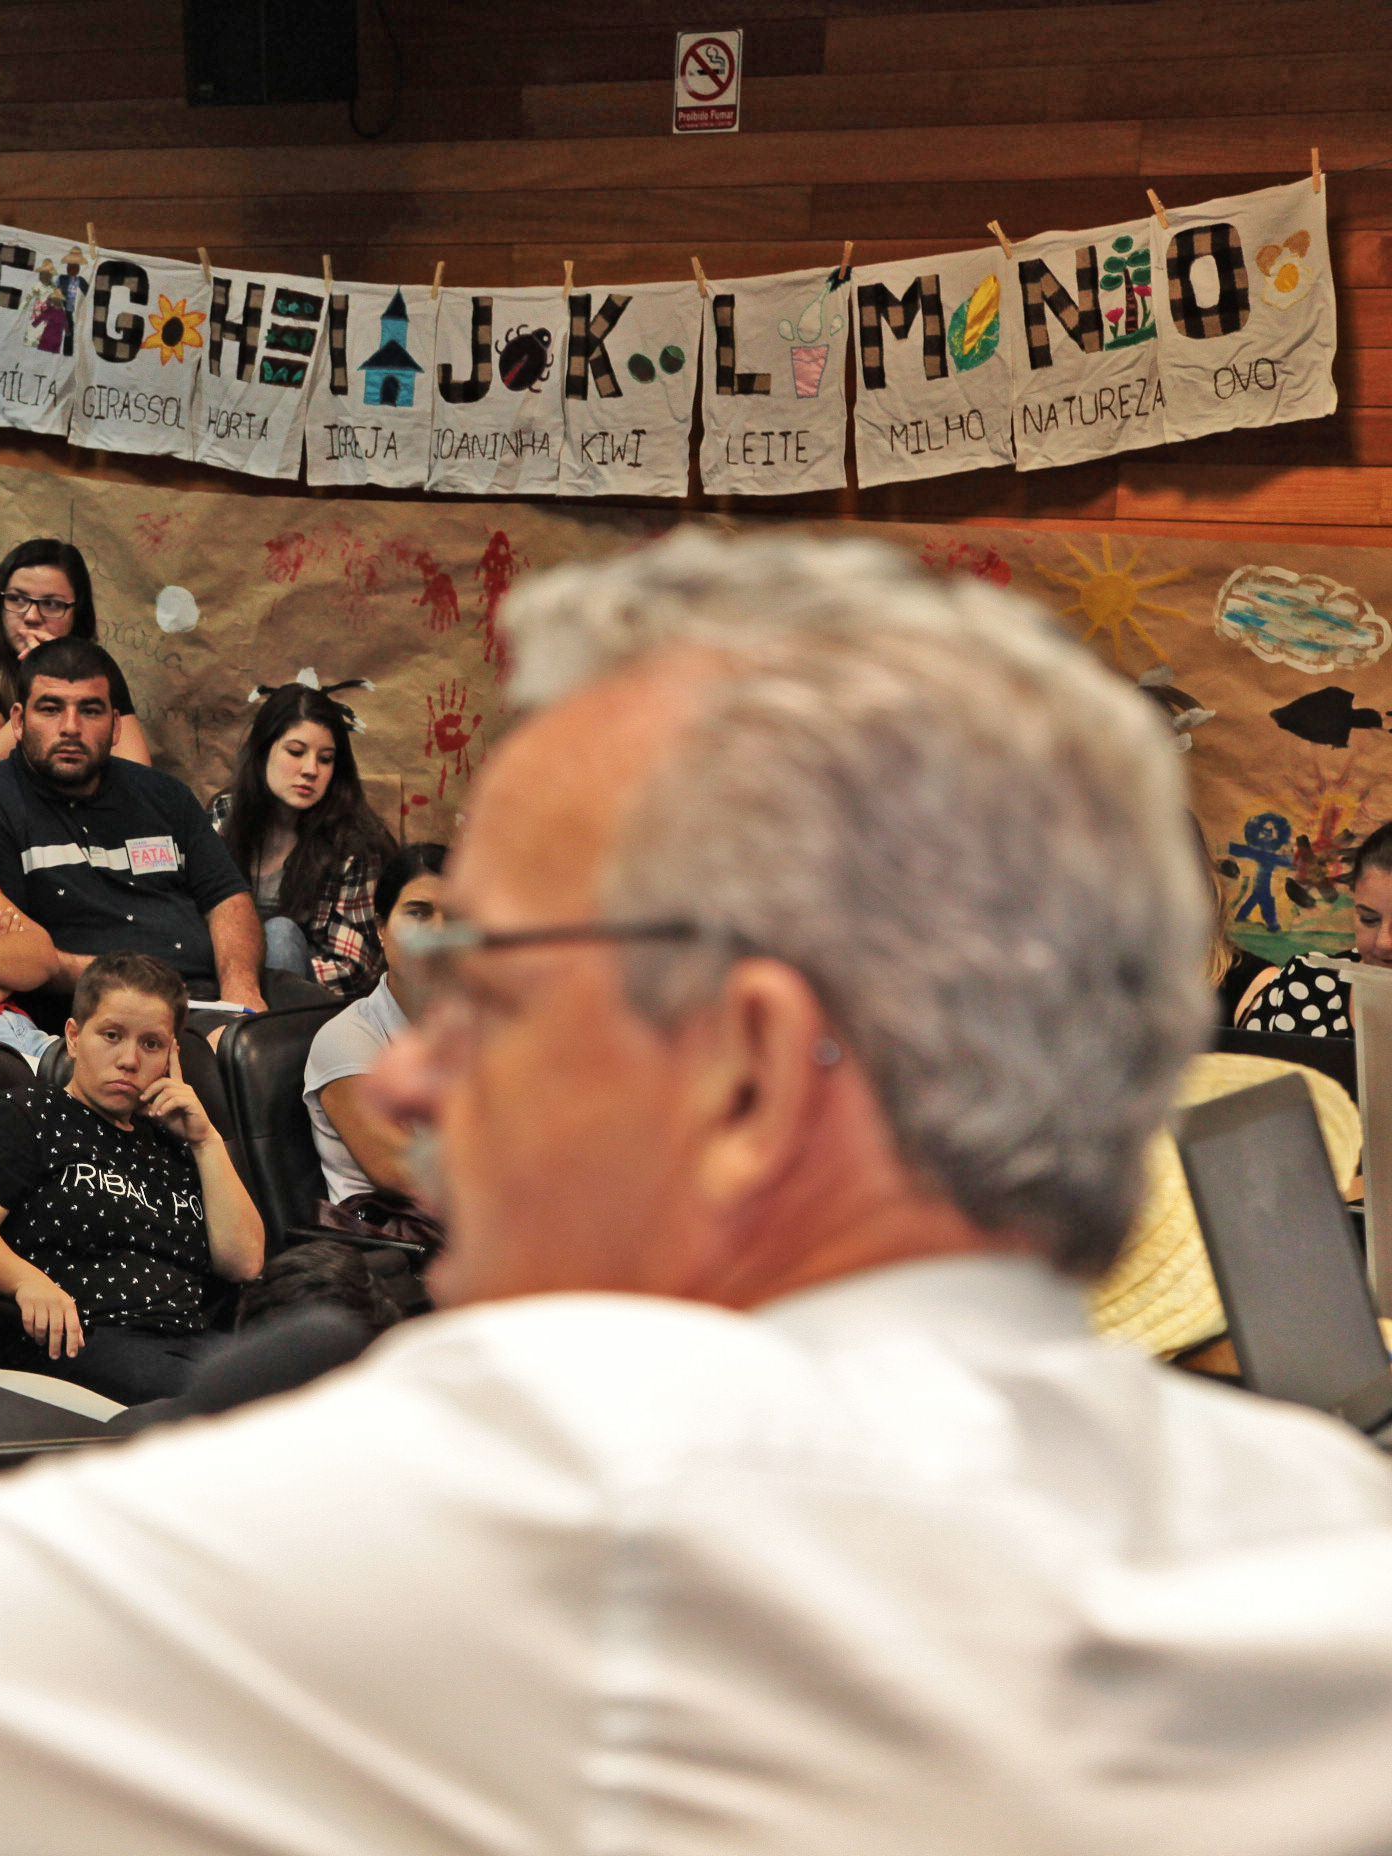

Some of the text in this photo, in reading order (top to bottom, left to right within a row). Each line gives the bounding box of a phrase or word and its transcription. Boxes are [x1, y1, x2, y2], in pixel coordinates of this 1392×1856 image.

[1018, 245, 1104, 370] N
[1166, 223, 1251, 340] O
[91, 260, 150, 364] G
[208, 276, 266, 383] H
[858, 274, 949, 390] M
[329, 294, 350, 396] I
[437, 296, 493, 404] J
[565, 293, 634, 401] K
[713, 294, 772, 396] L
[1214, 357, 1277, 400] OVO
[82, 384, 186, 431] GIRASSOL
[208, 406, 268, 441] HORTA
[889, 409, 986, 455] MILHO
[1023, 378, 1166, 435] NATUREZA
[323, 424, 398, 462] IGREJA
[433, 428, 551, 462] JOANINHA
[581, 429, 647, 467] KIWI
[726, 430, 810, 466] LEITE
[131, 848, 174, 864] FATAL
[60, 1163, 158, 1212] TRIBAL
